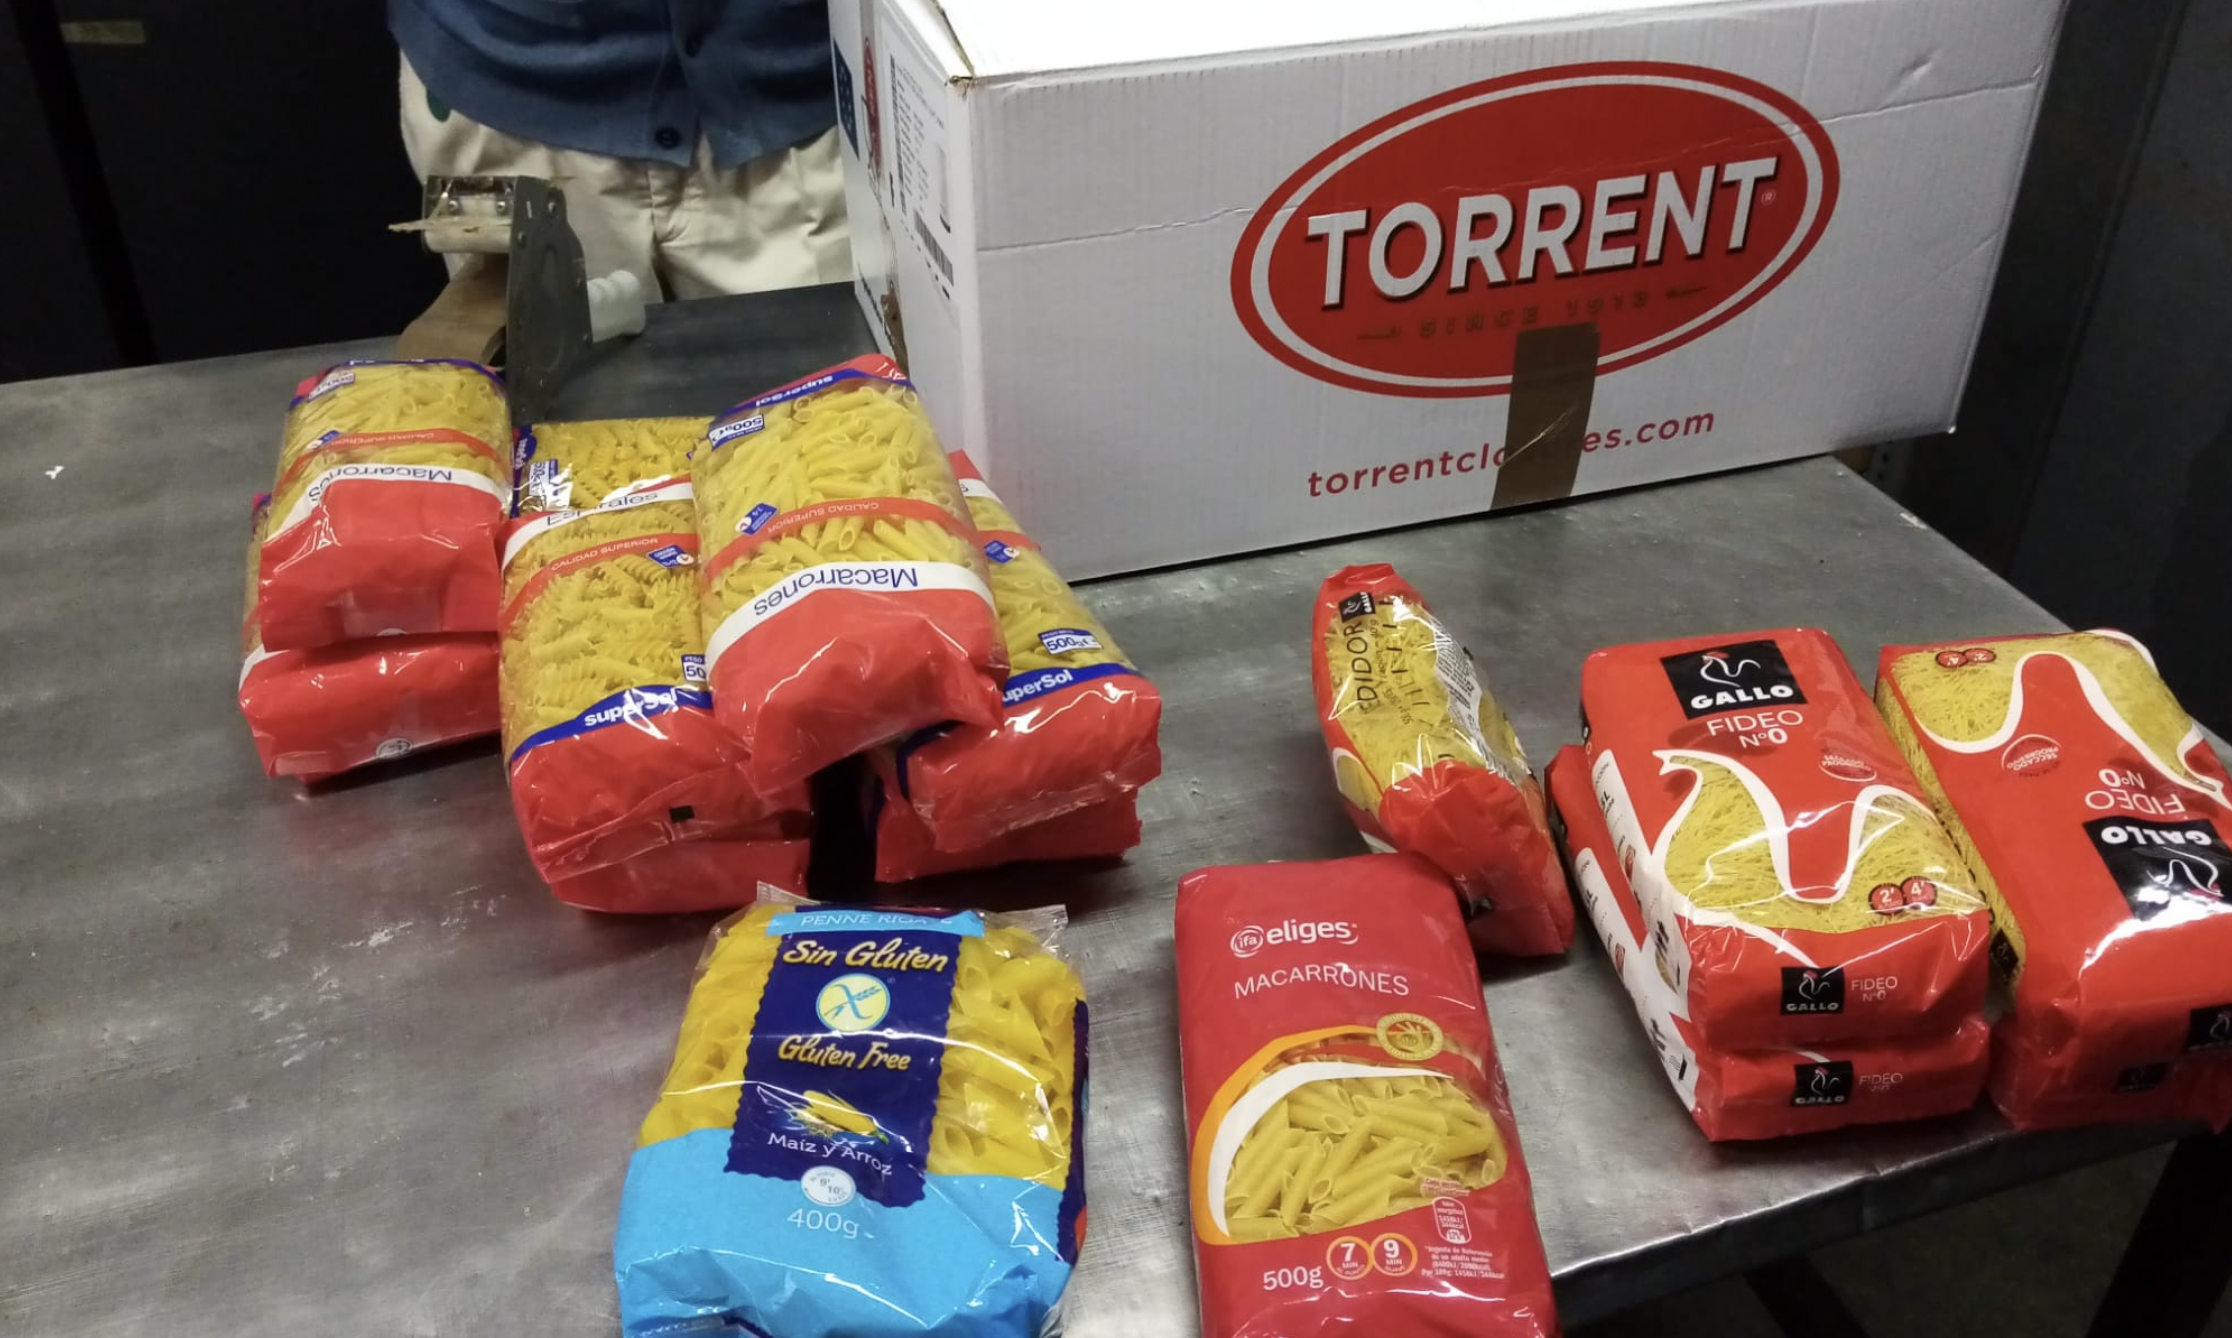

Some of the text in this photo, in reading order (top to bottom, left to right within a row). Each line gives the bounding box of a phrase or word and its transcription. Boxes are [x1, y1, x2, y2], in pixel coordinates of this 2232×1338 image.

[1305, 156, 1778, 308] TORRENT
[755, 374, 834, 407] superSol
[390, 432, 435, 442] CALIDAD
[767, 507, 826, 535] SUPERIOR
[828, 502, 879, 514] CALIDAD
[551, 537, 659, 571] CALIDAD SUPERIOR
[753, 567, 919, 617] Macarrones
[686, 665, 707, 679] 50
[1003, 669, 1074, 702] uperSol
[1690, 684, 1794, 710] GALLO
[1706, 709, 1804, 737] FIDEO
[2084, 788, 2186, 816] FIDEO
[2101, 825, 2212, 846] GALLO
[800, 913, 873, 927] PENNE
[1238, 918, 1352, 949] ifa eliges
[783, 936, 949, 973] Sin Gluten
[1234, 963, 1410, 1000] MACARRONES
[1851, 975, 1899, 992] FIDEO
[1786, 1001, 1840, 1012] GALLO
[778, 1034, 912, 1071] Gluten Free
[1795, 1095, 1846, 1105] GALLO
[767, 1132, 818, 1153] Maíz
[821, 1142, 838, 1158] y
[841, 1145, 893, 1176] Arroz
[786, 1208, 860, 1240] 400g
[1340, 1242, 1356, 1262] 7
[1383, 1239, 1400, 1259] 9
[1263, 1265, 1324, 1291] 500g
